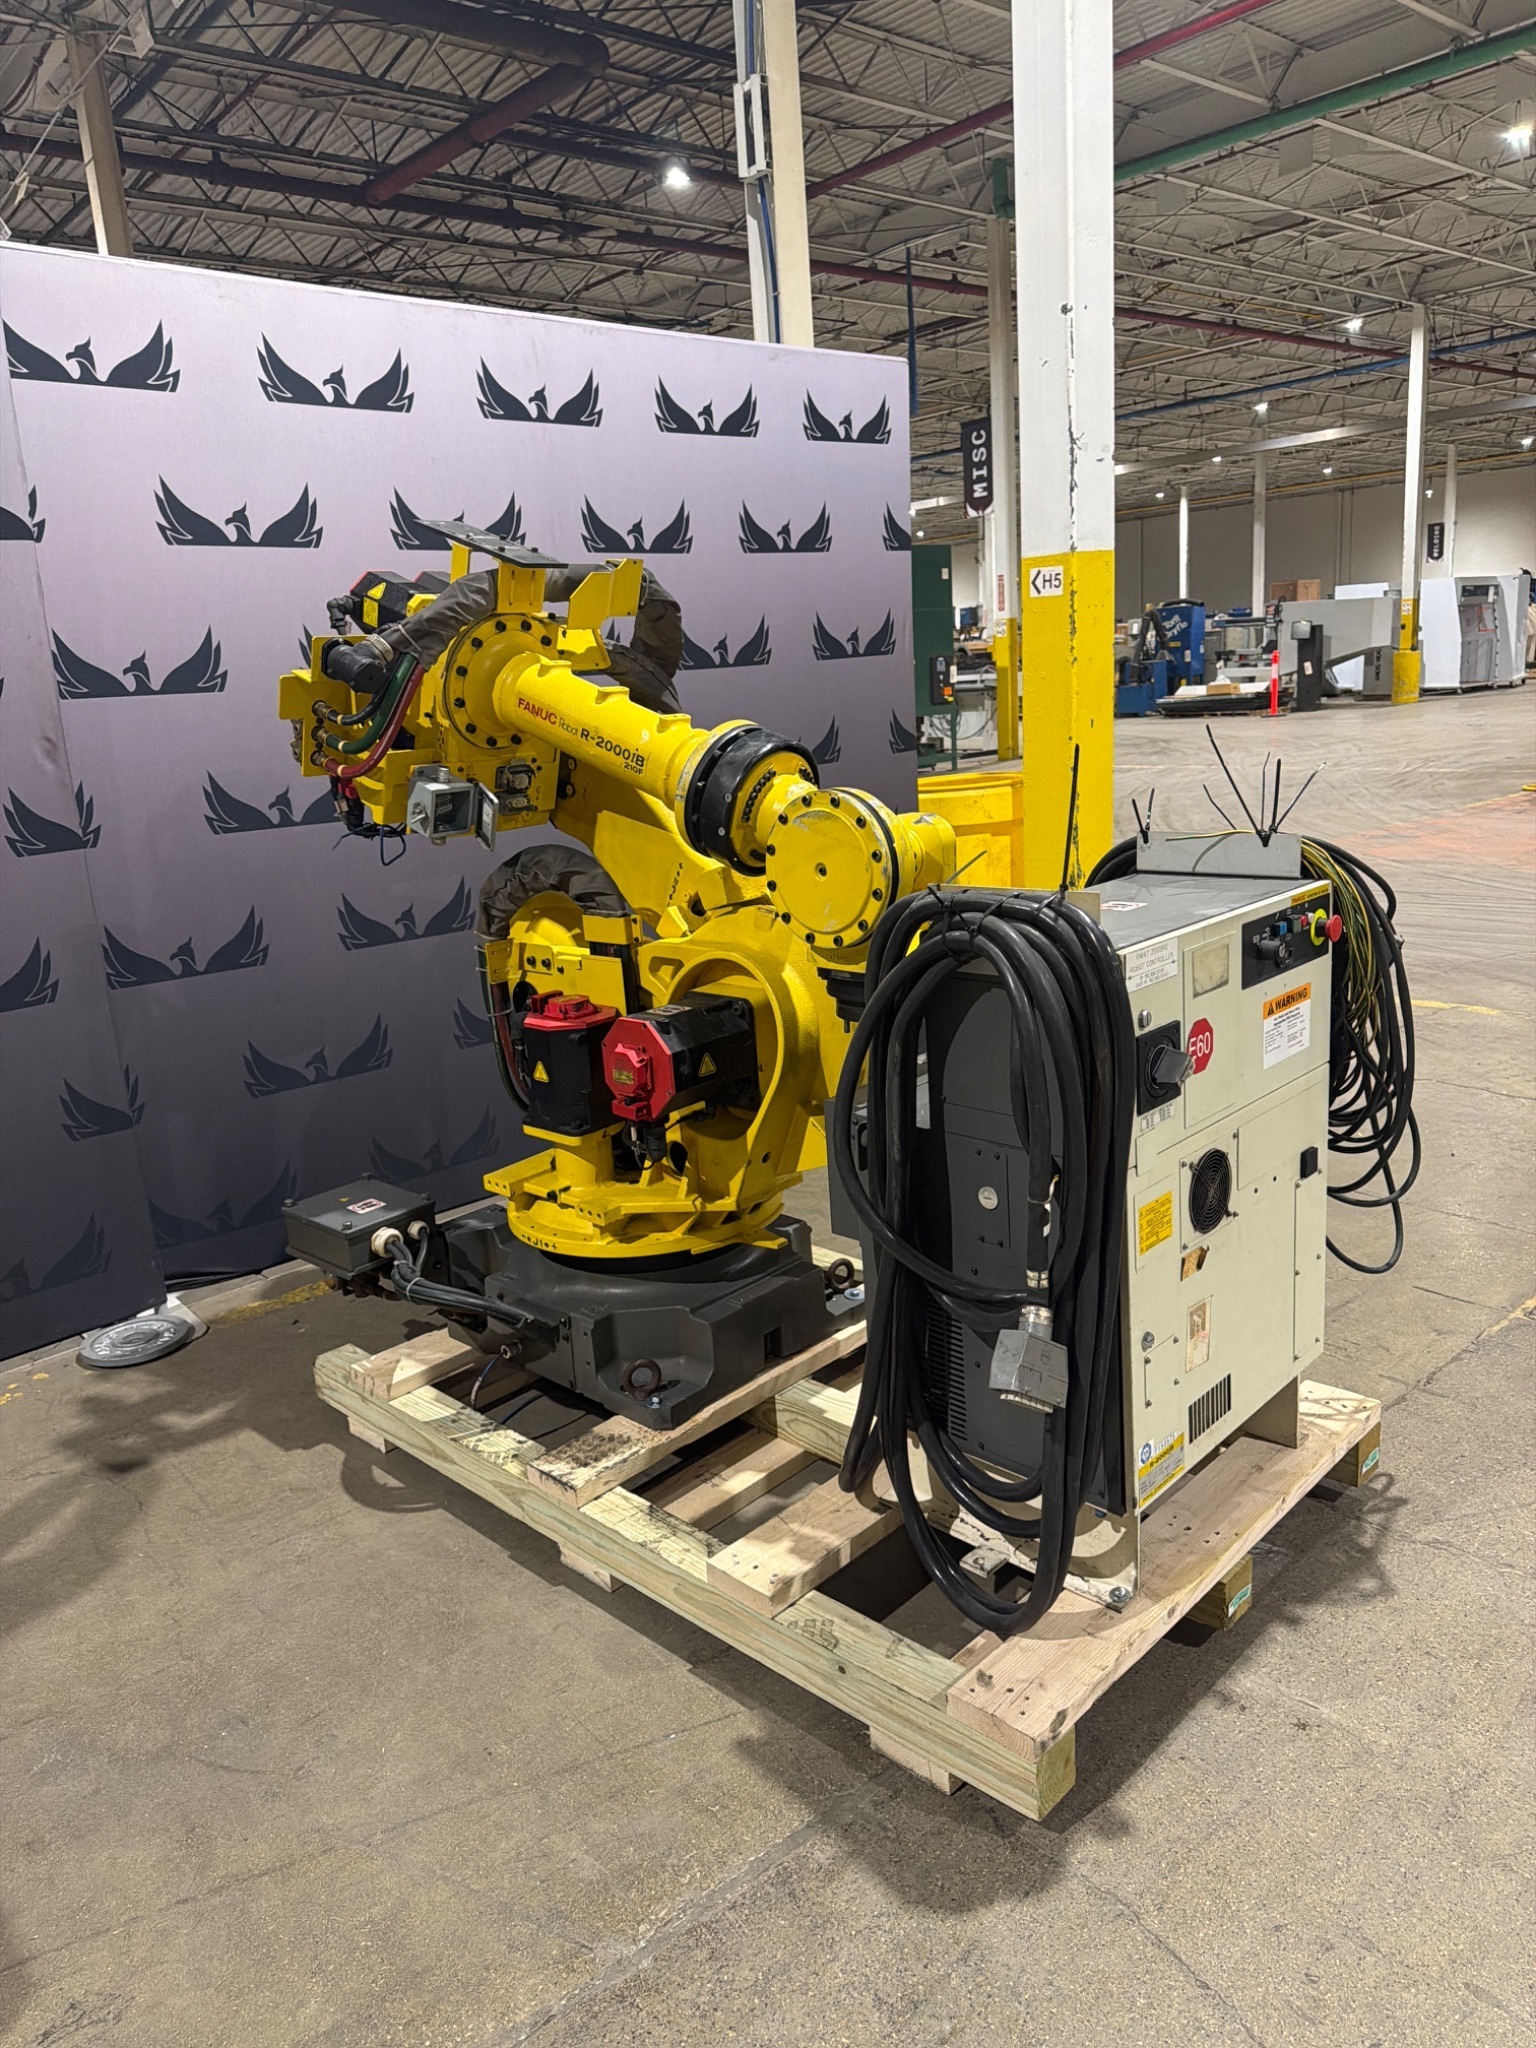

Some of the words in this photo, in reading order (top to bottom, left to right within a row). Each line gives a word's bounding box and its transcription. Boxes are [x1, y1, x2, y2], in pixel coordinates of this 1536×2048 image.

[971, 429, 988, 498] MISC
[1042, 573, 1062, 589] H5
[517, 697, 558, 725] FANUC
[558, 716, 579, 736] Robot
[580, 728, 645, 768] R-2000iB
[624, 762, 644, 775] 210F
[1129, 962, 1145, 973] ROBOT
[1146, 951, 1174, 967] CONTROLLER
[1275, 987, 1308, 1011] WARNING
